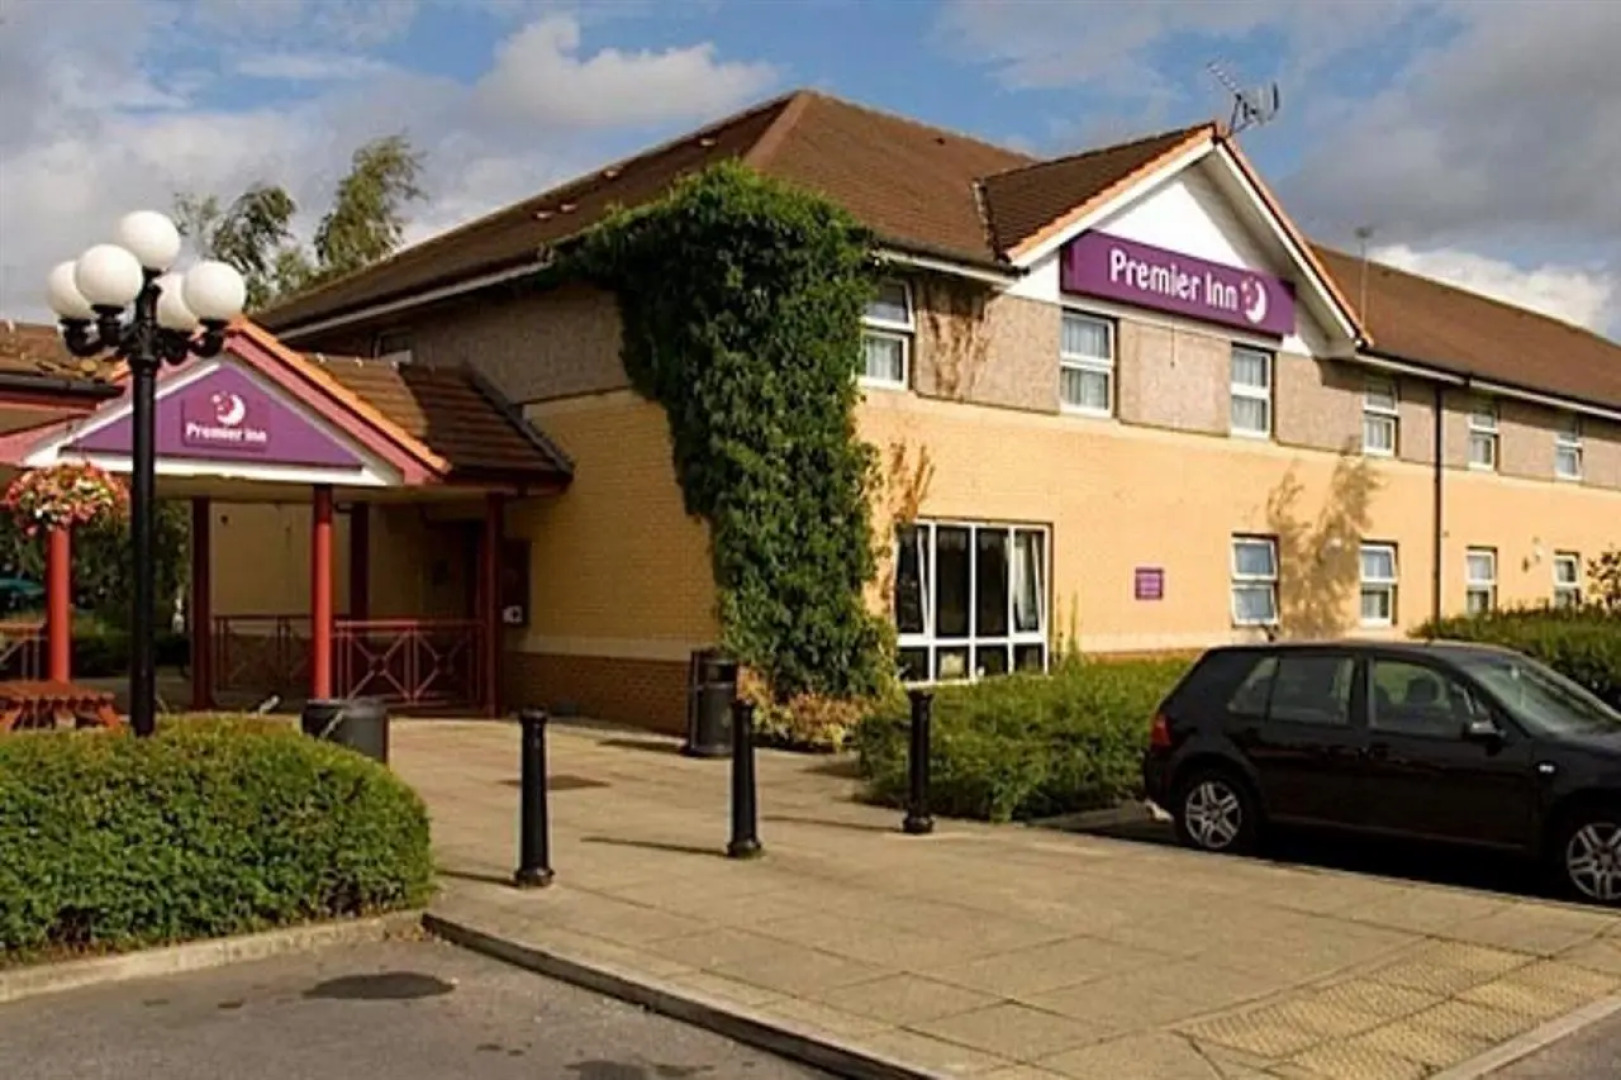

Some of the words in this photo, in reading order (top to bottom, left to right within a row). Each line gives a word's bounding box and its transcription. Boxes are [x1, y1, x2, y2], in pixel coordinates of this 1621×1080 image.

[1109, 248, 1200, 301] Premier
[1205, 271, 1239, 311] Inn
[186, 422, 242, 442] Premier
